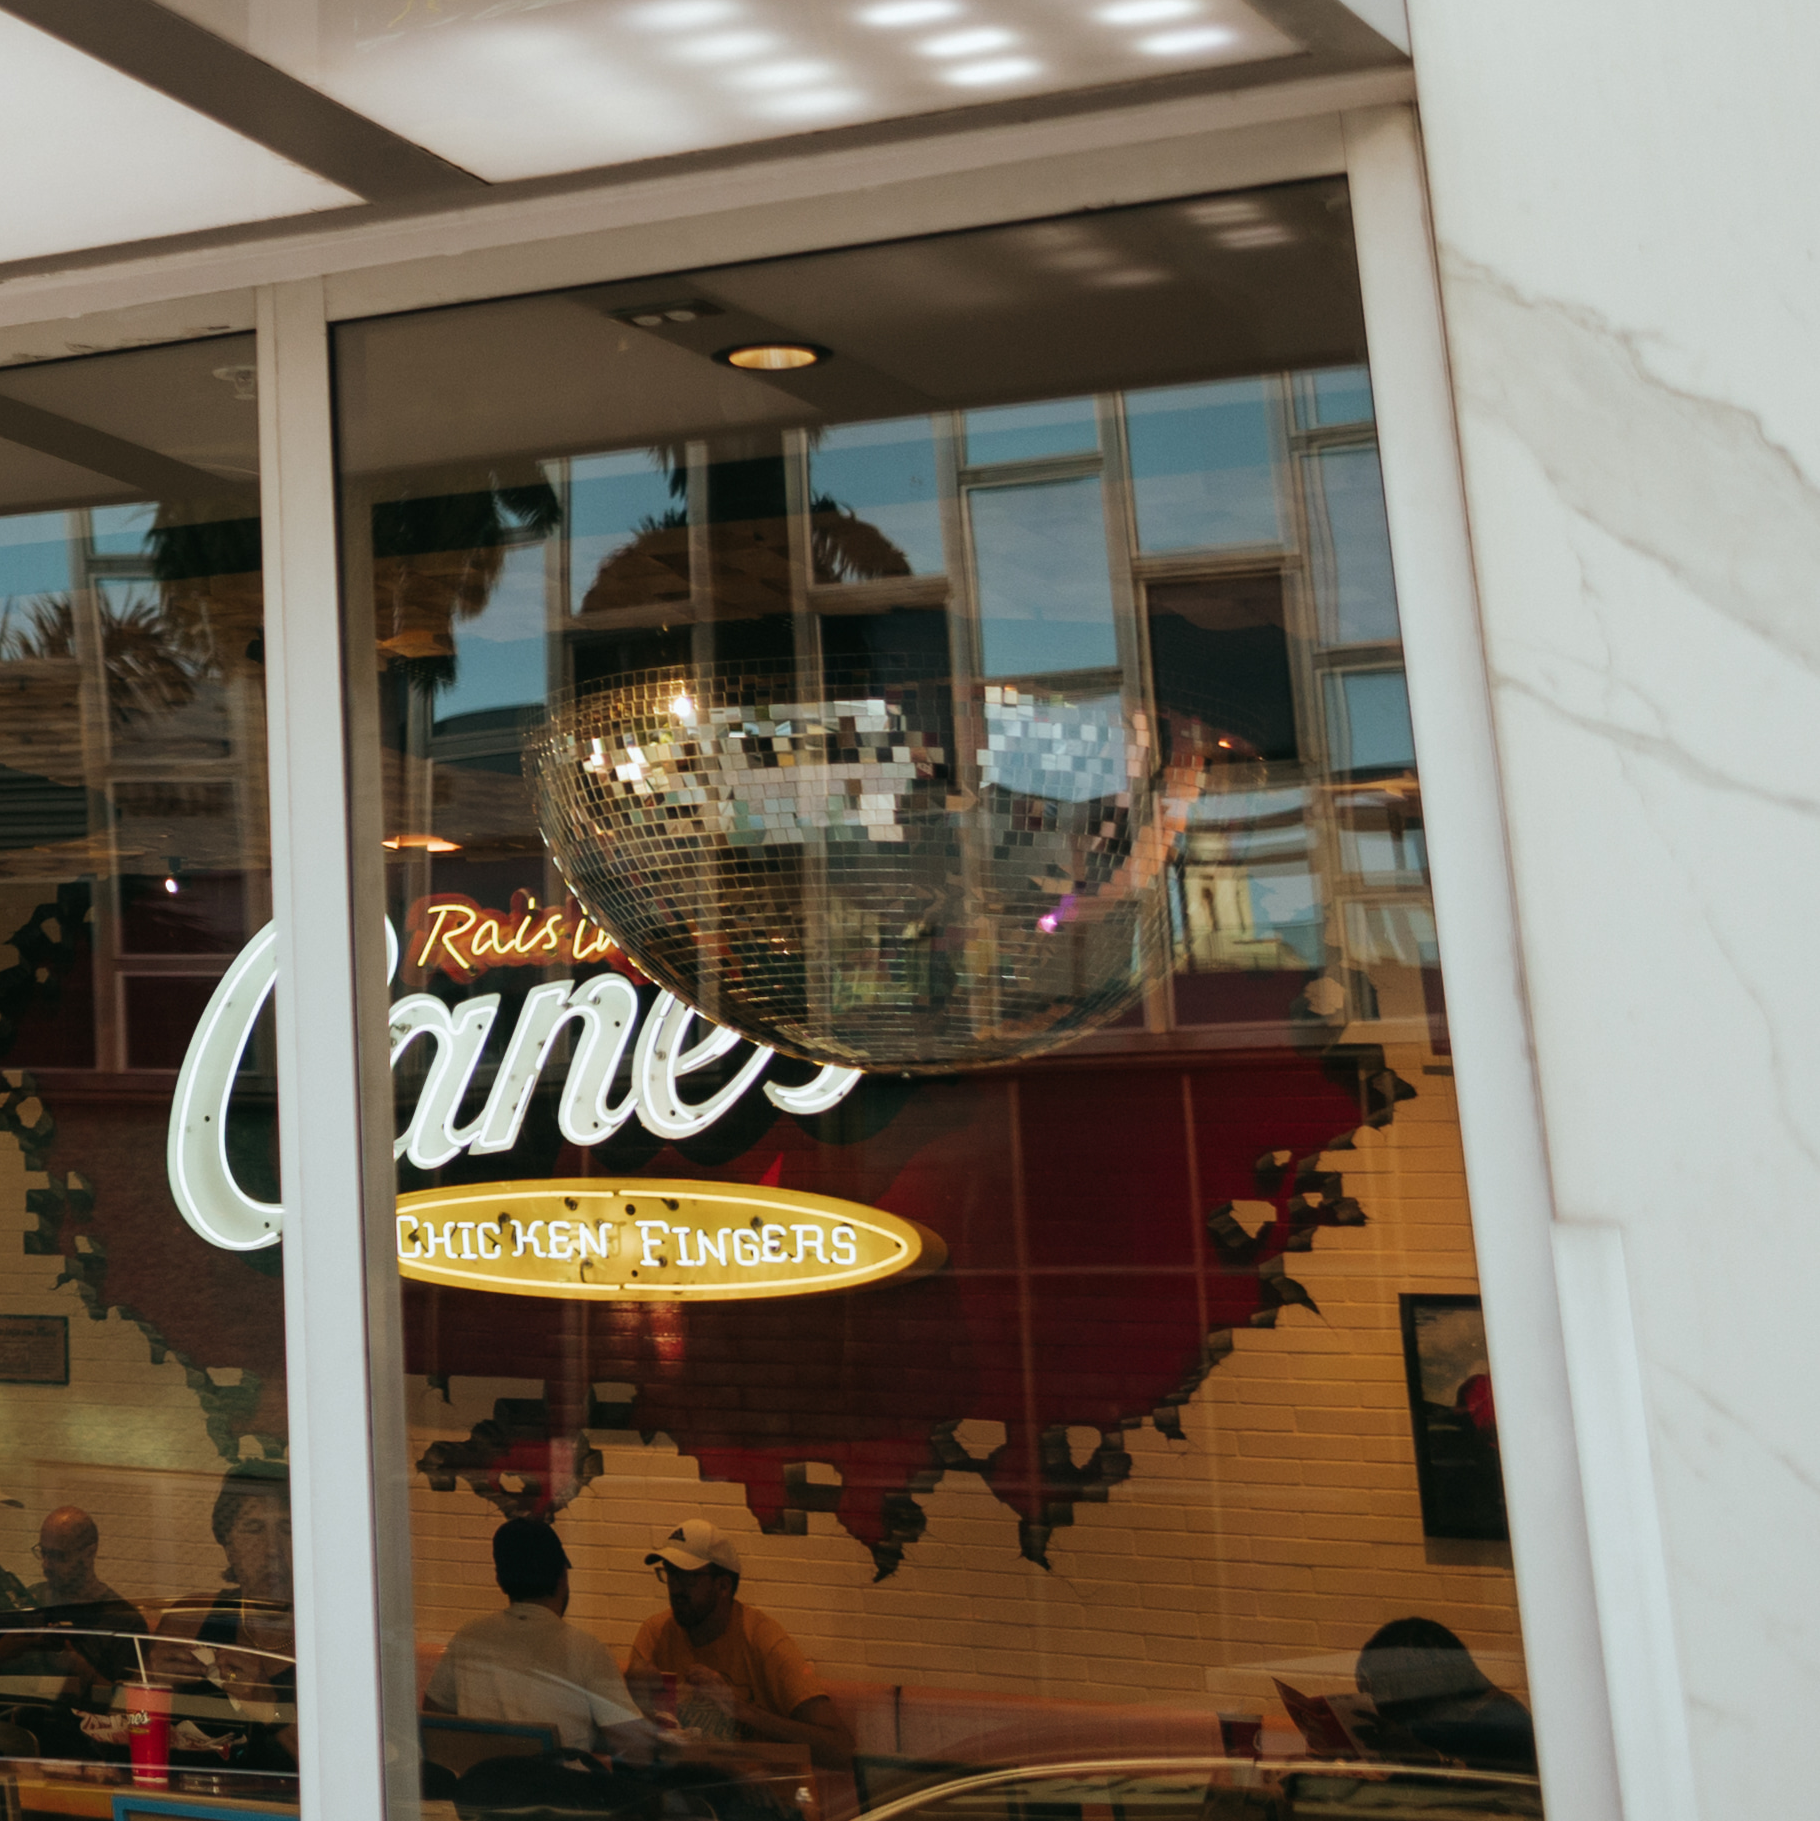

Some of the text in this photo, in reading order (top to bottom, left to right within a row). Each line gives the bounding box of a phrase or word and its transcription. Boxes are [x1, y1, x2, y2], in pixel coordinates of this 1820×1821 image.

[417, 896, 612, 970] Raisi
[167, 913, 863, 1251] Cane
[395, 1214, 857, 1267] CHICKEN FINGERS
